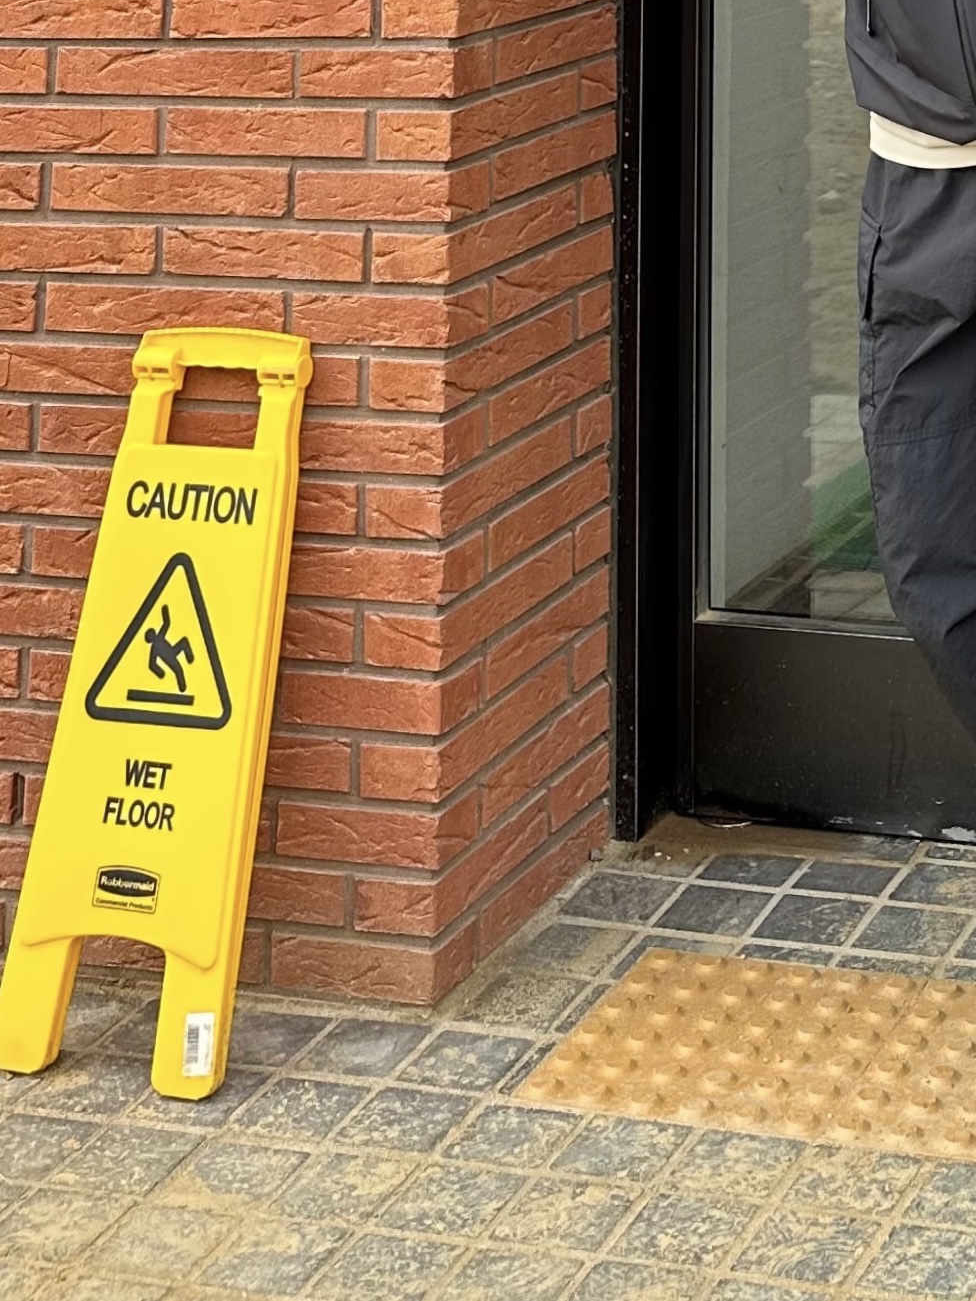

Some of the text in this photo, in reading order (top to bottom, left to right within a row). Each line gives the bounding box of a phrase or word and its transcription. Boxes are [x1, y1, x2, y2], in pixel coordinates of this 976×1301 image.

[126, 480, 259, 526] CAUTION
[125, 758, 173, 791] WET
[102, 796, 176, 832] FLOOR
